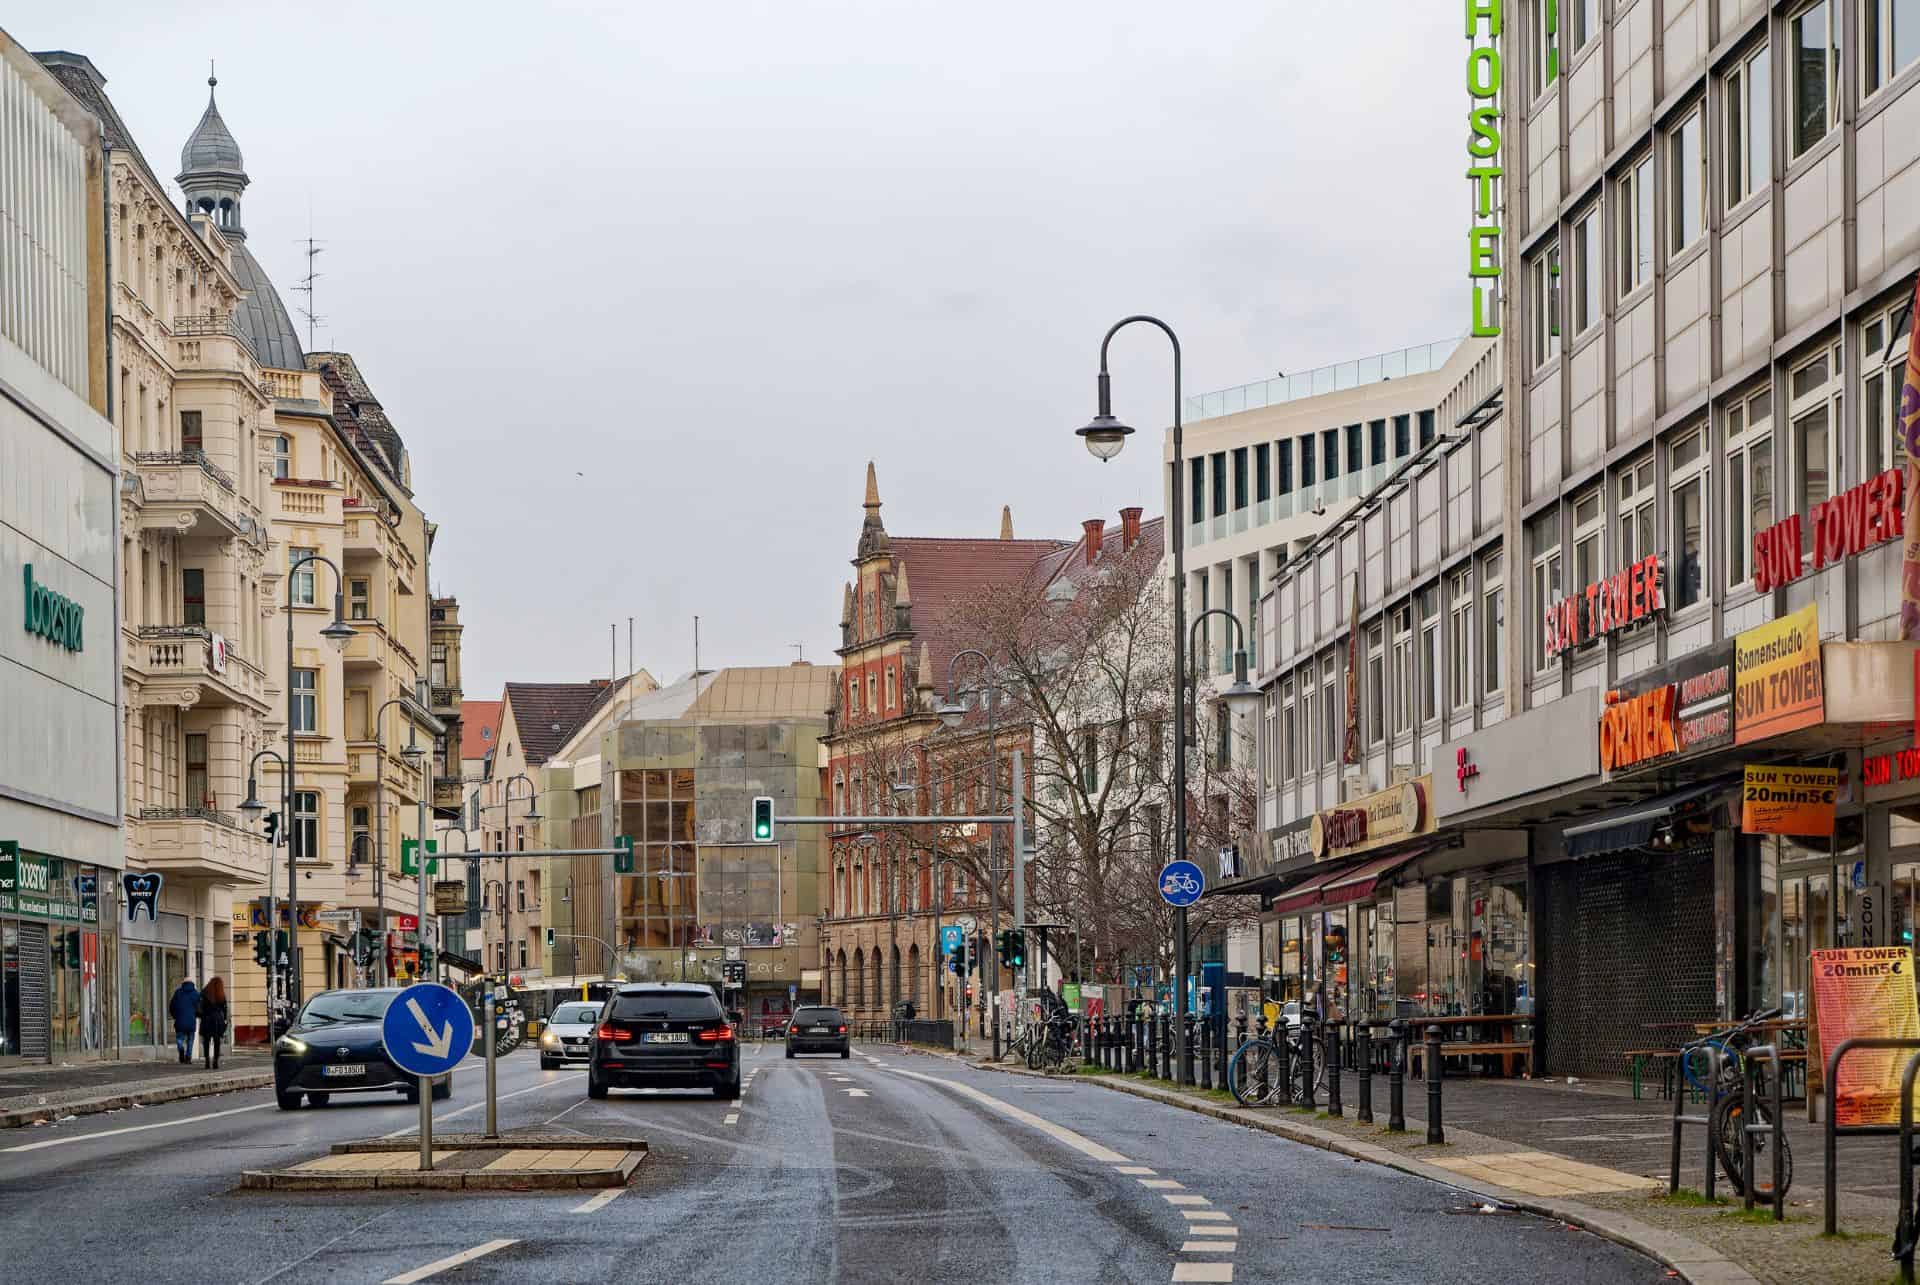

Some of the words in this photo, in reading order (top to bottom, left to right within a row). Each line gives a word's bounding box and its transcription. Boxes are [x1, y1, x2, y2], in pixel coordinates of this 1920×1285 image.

[1466, 0, 1502, 337] HOSTEL
[1755, 514, 1801, 593] SUN
[1810, 469, 1903, 570] TOWER
[23, 563, 84, 652] boesner
[1545, 595, 1579, 656] SUN
[1586, 555, 1659, 638] TOWER
[1737, 627, 1802, 672] Sonnenstudio
[1736, 681, 1765, 720] SUN
[1769, 658, 1821, 710] TOWER
[1745, 771, 1778, 783] SUN
[1782, 773, 1838, 785] TOWER
[1863, 754, 1891, 786] SUN
[1815, 949, 1849, 962] SUN
[1855, 948, 1907, 960] TOWER
